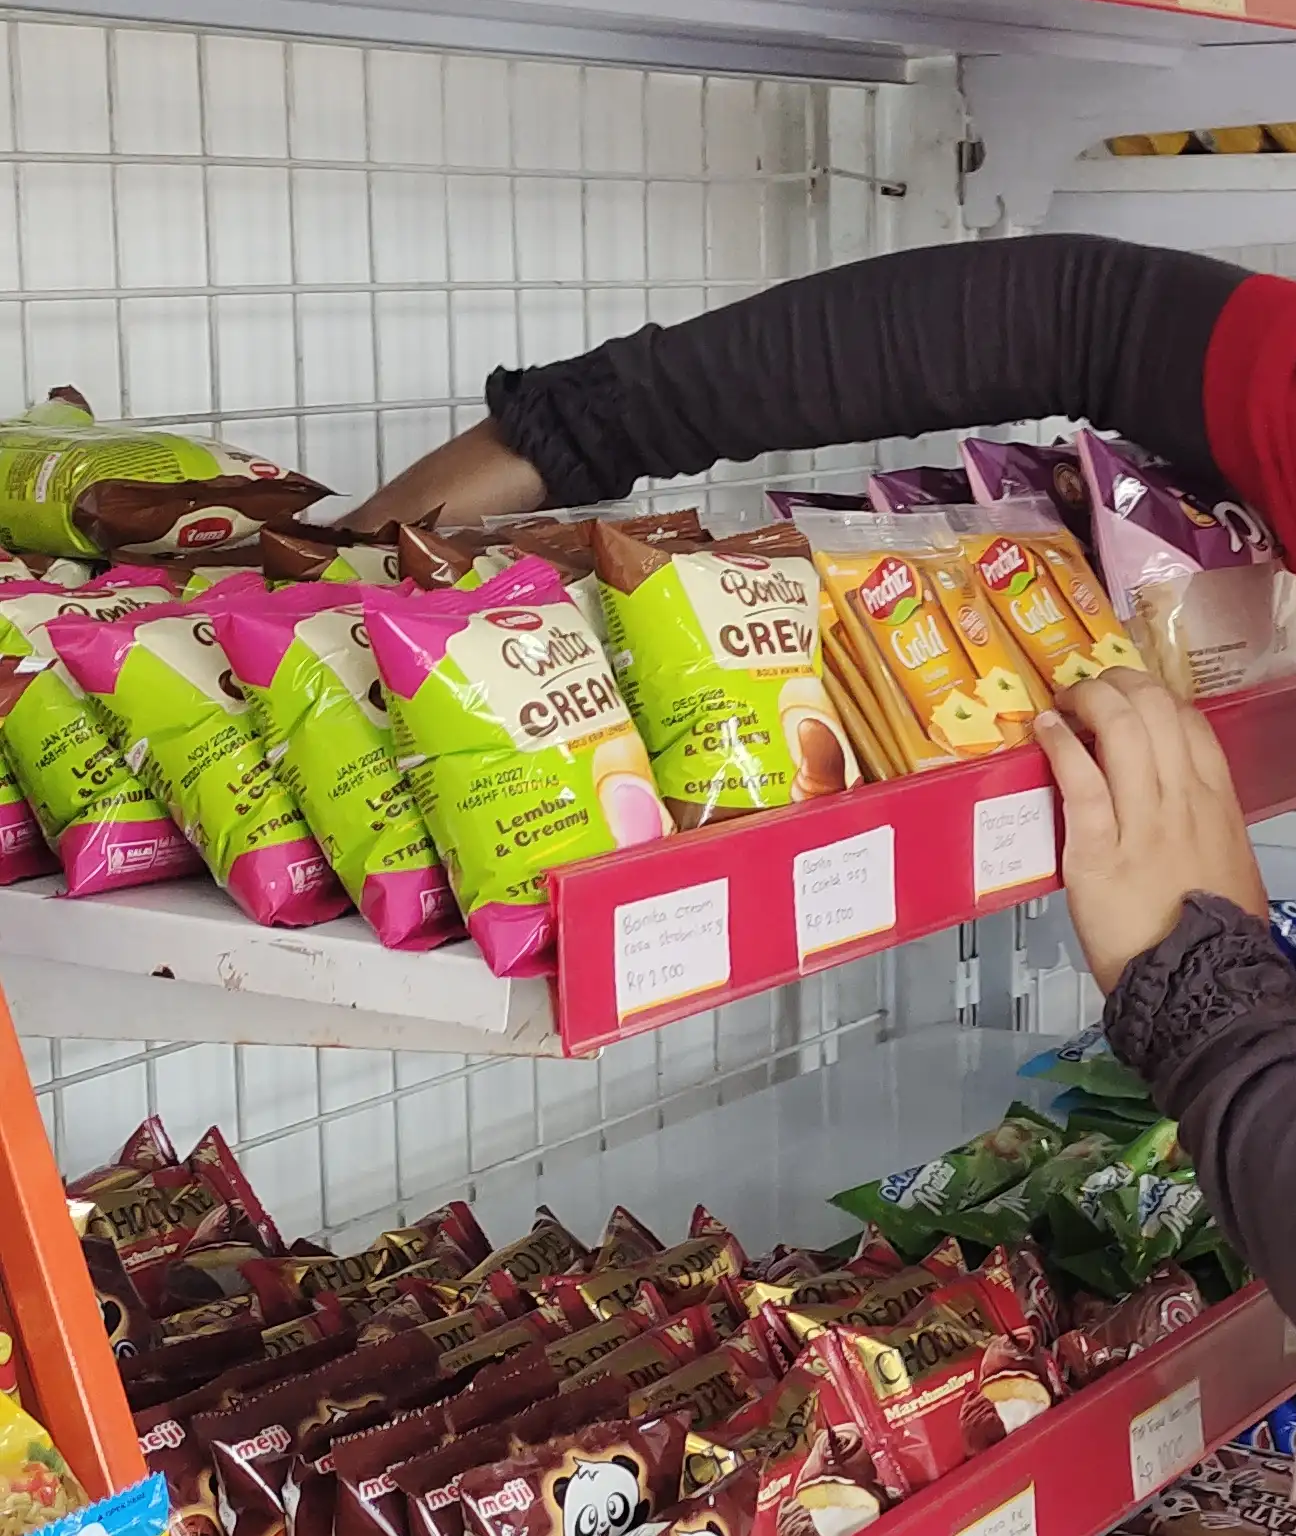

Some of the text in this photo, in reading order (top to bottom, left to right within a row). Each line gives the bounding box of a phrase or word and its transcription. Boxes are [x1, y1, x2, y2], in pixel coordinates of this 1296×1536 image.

[495, 806, 590, 858] & Creamy
[236, 1425, 292, 1461] meiji
[479, 1478, 536, 1516] meiji
